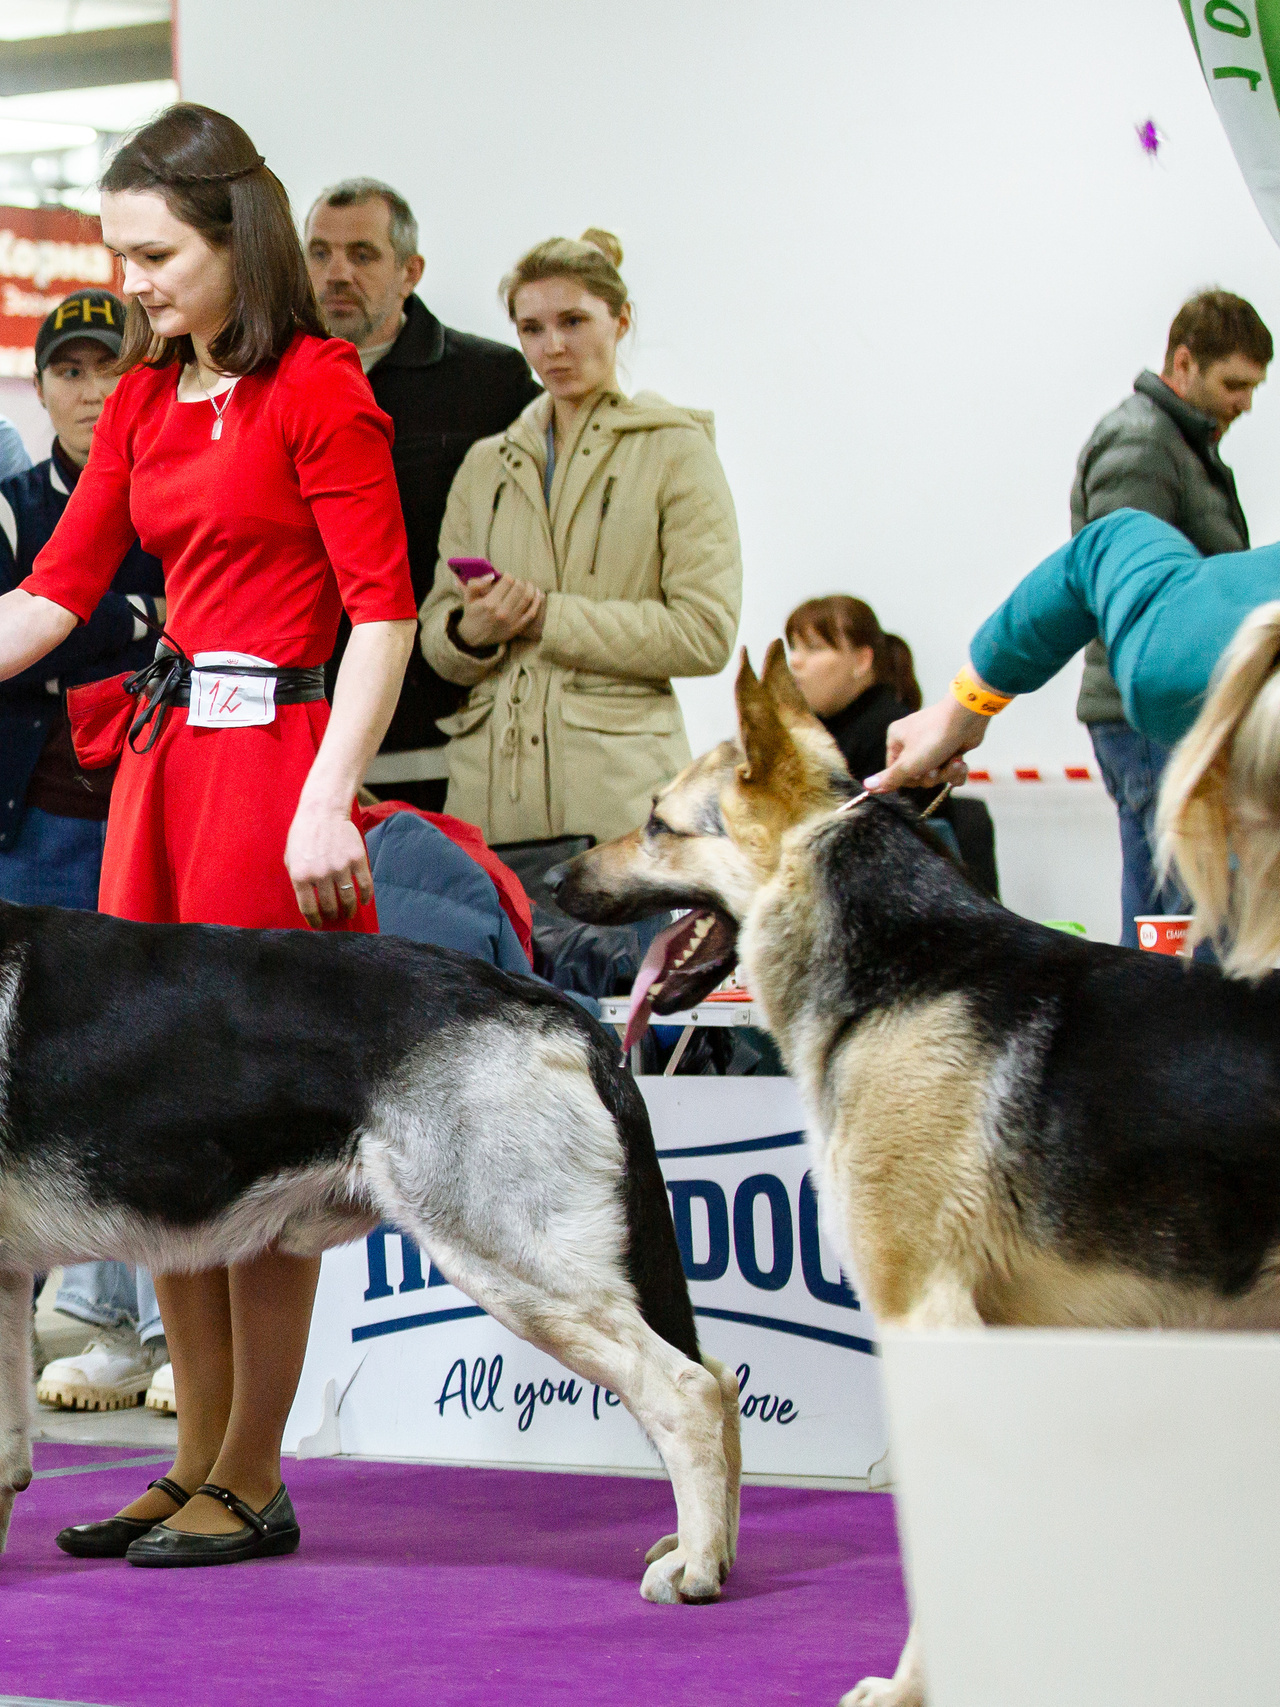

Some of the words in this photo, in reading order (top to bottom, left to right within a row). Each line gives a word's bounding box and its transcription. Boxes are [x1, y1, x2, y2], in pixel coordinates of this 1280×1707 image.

[53, 299, 115, 331] FH
[434, 1353, 505, 1419] All
[514, 1378, 583, 1432] you
[734, 1363, 799, 1425] love
